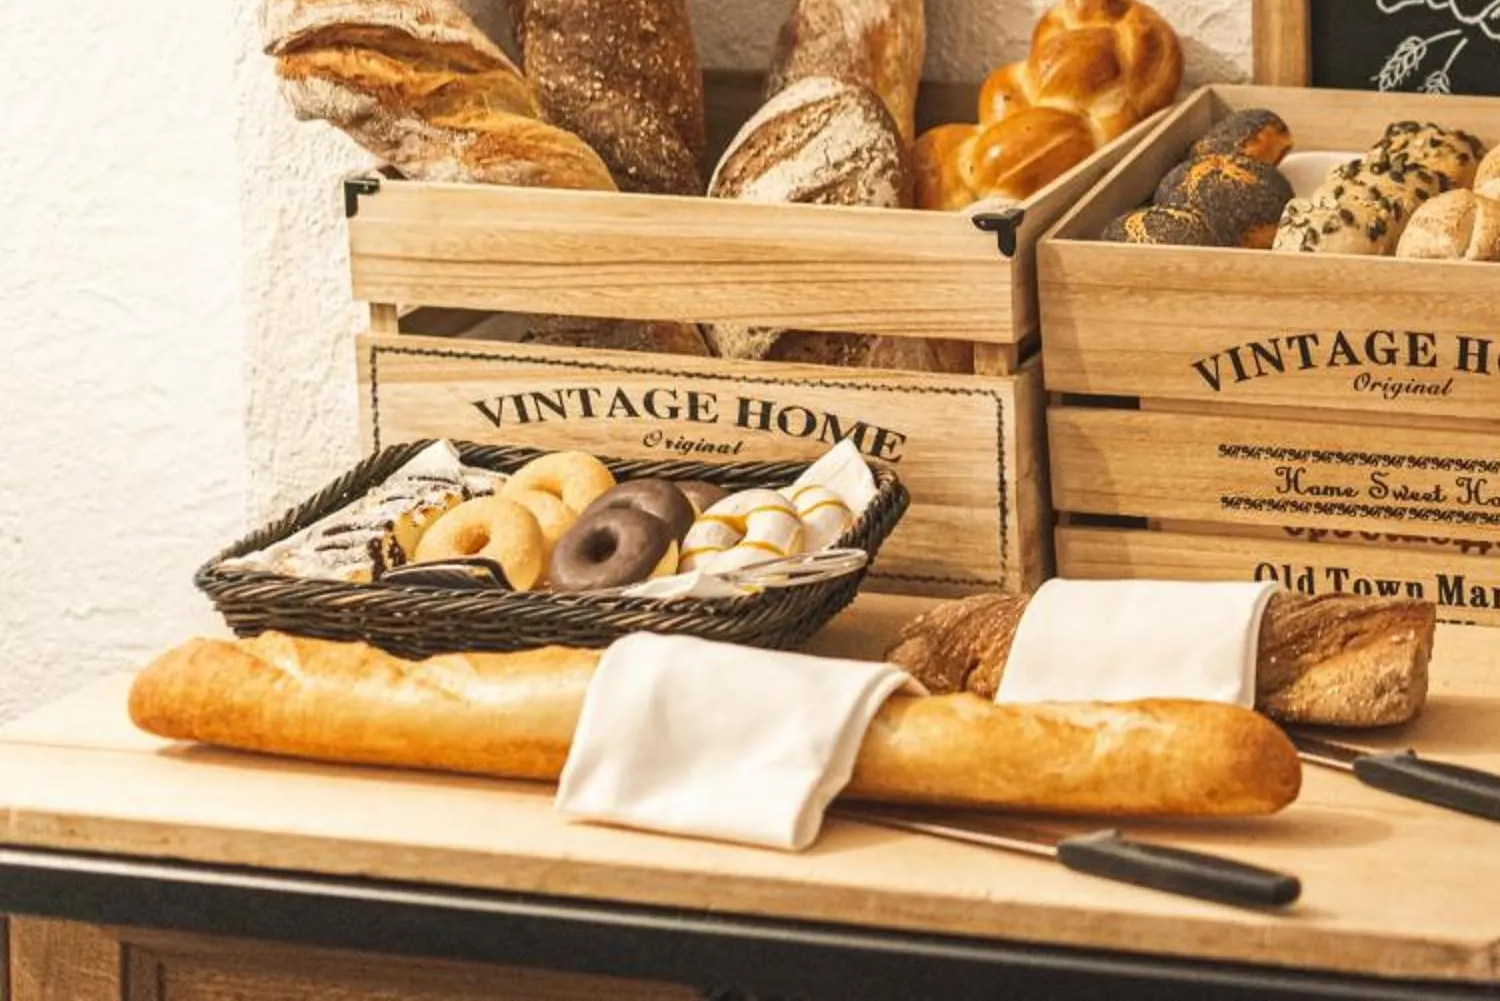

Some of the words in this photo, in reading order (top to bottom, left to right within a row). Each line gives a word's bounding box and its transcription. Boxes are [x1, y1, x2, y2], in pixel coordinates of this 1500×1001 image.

[1190, 330, 1438, 393] VINTAGE
[1352, 372, 1454, 398] Original
[472, 387, 720, 429] VINTAGE
[734, 396, 908, 463] HOME
[641, 430, 745, 456] Original
[1368, 472, 1448, 504] Sweet
[1254, 562, 1316, 597] Old
[1325, 567, 1425, 600] Town
